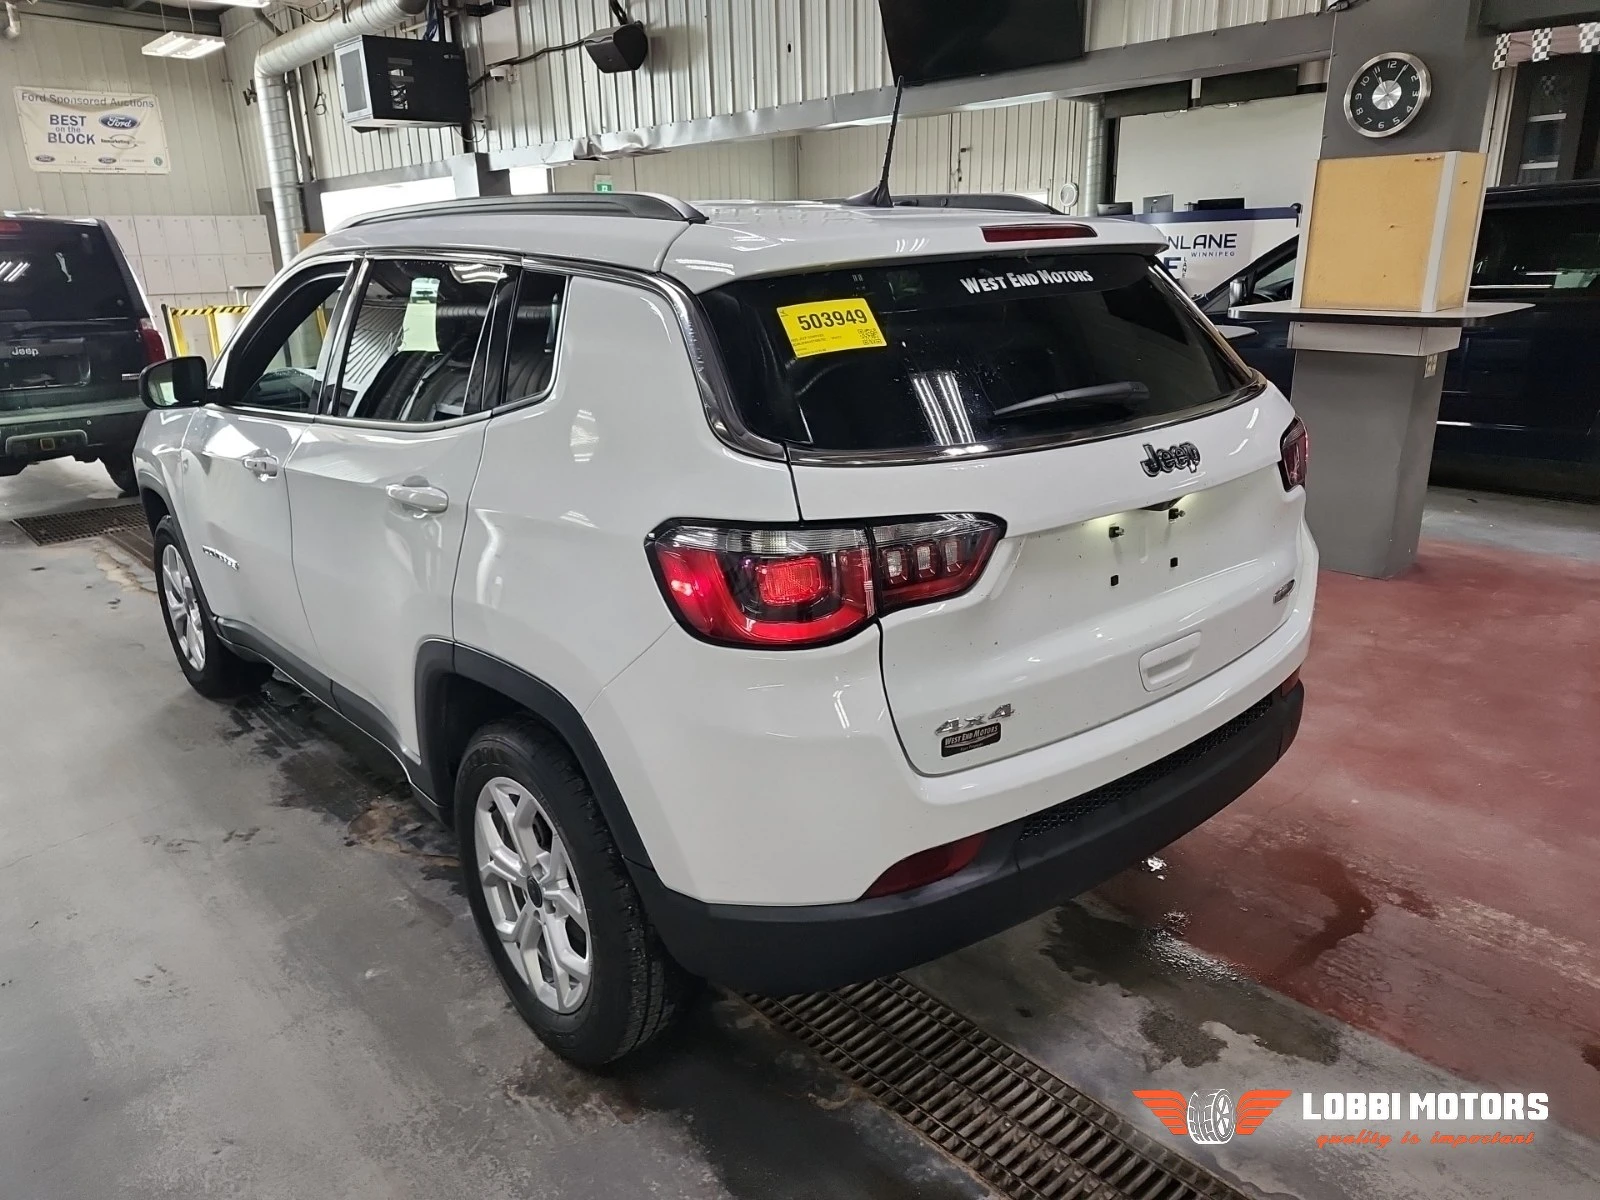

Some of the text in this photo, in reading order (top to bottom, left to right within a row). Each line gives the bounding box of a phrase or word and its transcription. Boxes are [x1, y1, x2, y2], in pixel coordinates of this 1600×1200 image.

[1374, 66, 1381, 74] 11
[1360, 76, 1369, 86] 10
[1410, 73, 1419, 82] 2
[21, 91, 155, 108] Ford Sponsored Auctions
[1355, 92, 1362, 100] 9
[1356, 107, 1363, 115] 8
[1406, 105, 1413, 113] 4
[49, 114, 87, 127] BEST
[1393, 116, 1400, 125] 5
[67, 125, 81, 133] the
[47, 132, 96, 145] BLOCK
[1165, 233, 1238, 250] NLANE
[960, 269, 1094, 294] WEST END MOTORS
[797, 309, 868, 331] 503949
[11, 346, 39, 357] Jeep
[1140, 442, 1200, 478] Jeep
[945, 725, 998, 745] WEST END MOTORS
